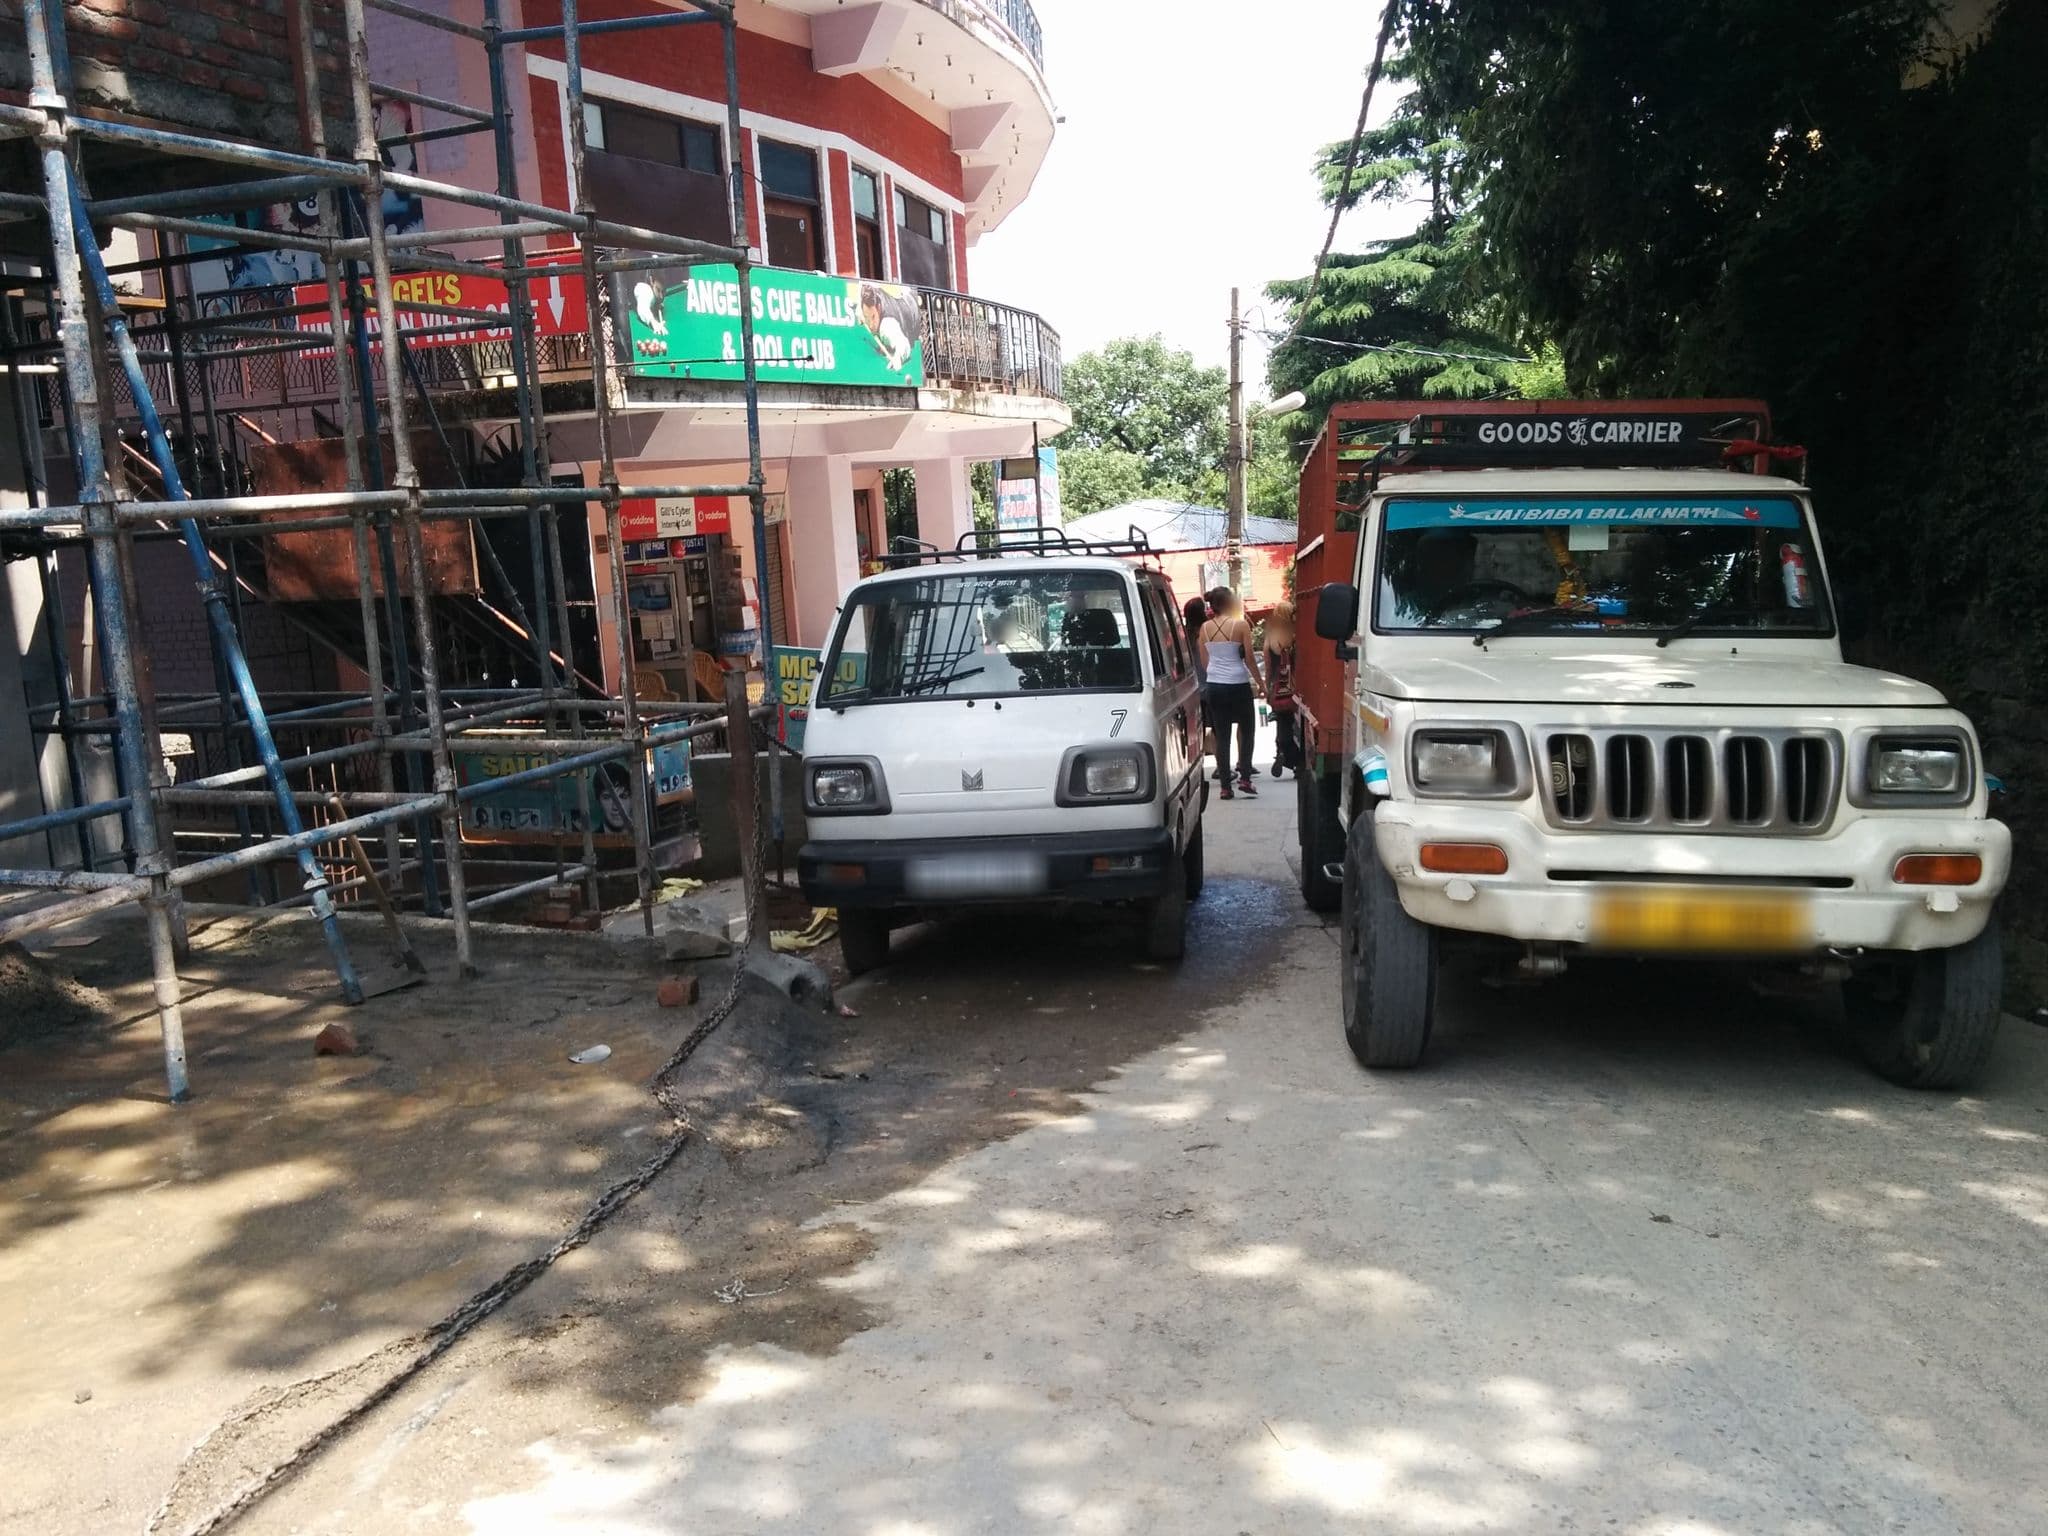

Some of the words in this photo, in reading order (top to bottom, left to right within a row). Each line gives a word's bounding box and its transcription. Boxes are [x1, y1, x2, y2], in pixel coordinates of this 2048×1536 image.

[686, 278, 763, 320] ANGES
[766, 287, 803, 323] CUE
[804, 292, 857, 328] BALLS
[721, 330, 737, 366] &
[741, 333, 790, 369] OOL
[790, 336, 836, 371] CLUB
[1478, 420, 1563, 444] GOODS
[1590, 420, 1683, 444] CARRIER
[629, 515, 655, 526] vodafone
[675, 506, 692, 519] Cyber
[704, 510, 727, 521] vodafone
[1486, 508, 1520, 521] JAI
[1525, 508, 1582, 520] BABA
[1586, 507, 1658, 519] BALAK
[1660, 507, 1720, 519] NATH
[1109, 709, 1128, 738] 7
